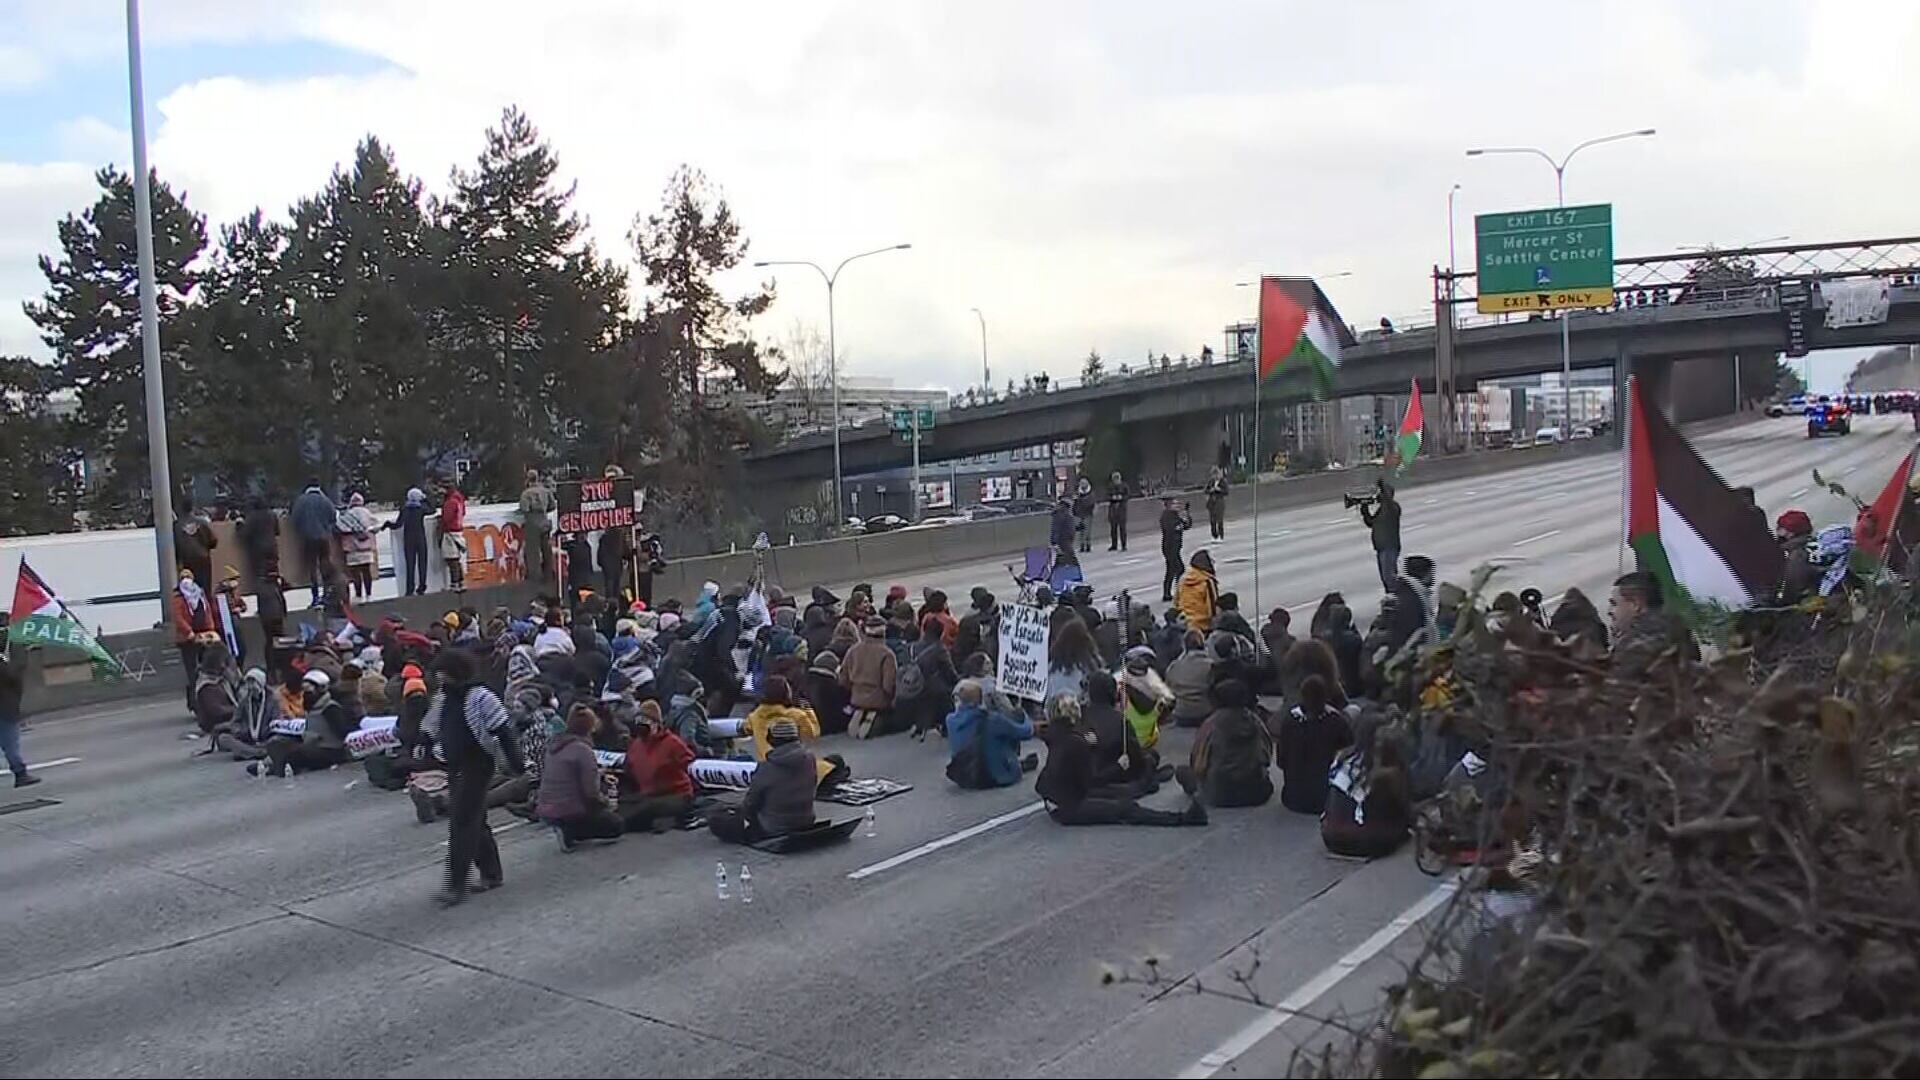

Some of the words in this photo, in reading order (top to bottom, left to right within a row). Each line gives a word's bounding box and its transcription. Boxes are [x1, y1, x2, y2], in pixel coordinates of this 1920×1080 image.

[1507, 215, 1535, 228] EXIT
[1545, 210, 1577, 226] 167
[1503, 235, 1557, 249] Mercer
[1566, 231, 1583, 245] St
[1485, 251, 1541, 266] Seattle
[1549, 248, 1604, 261] Center
[1503, 297, 1530, 307] EXIT
[1558, 293, 1592, 304] ONLY
[581, 482, 613, 501] STOP
[560, 508, 633, 532] GENOCIDE
